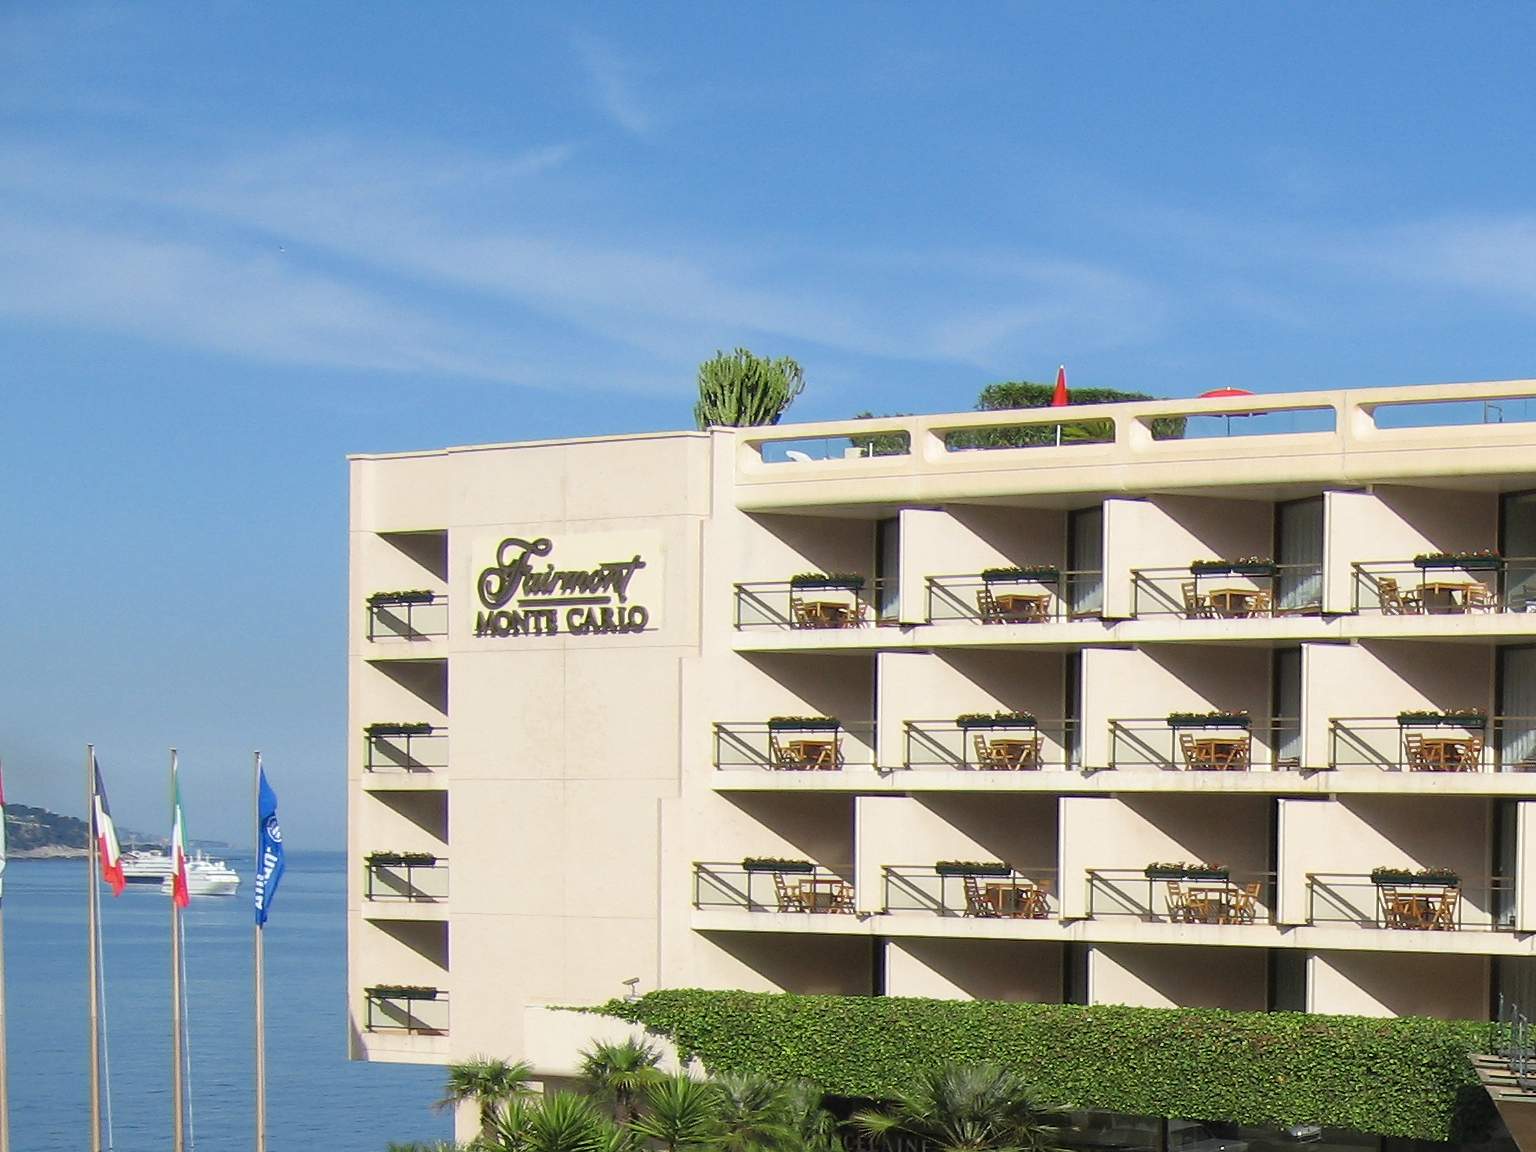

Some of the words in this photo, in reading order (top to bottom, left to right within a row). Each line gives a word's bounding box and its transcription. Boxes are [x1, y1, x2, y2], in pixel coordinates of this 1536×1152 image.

[477, 538, 646, 609] Fairmont
[475, 609, 558, 638] MONTE
[566, 605, 649, 635] CARLO
